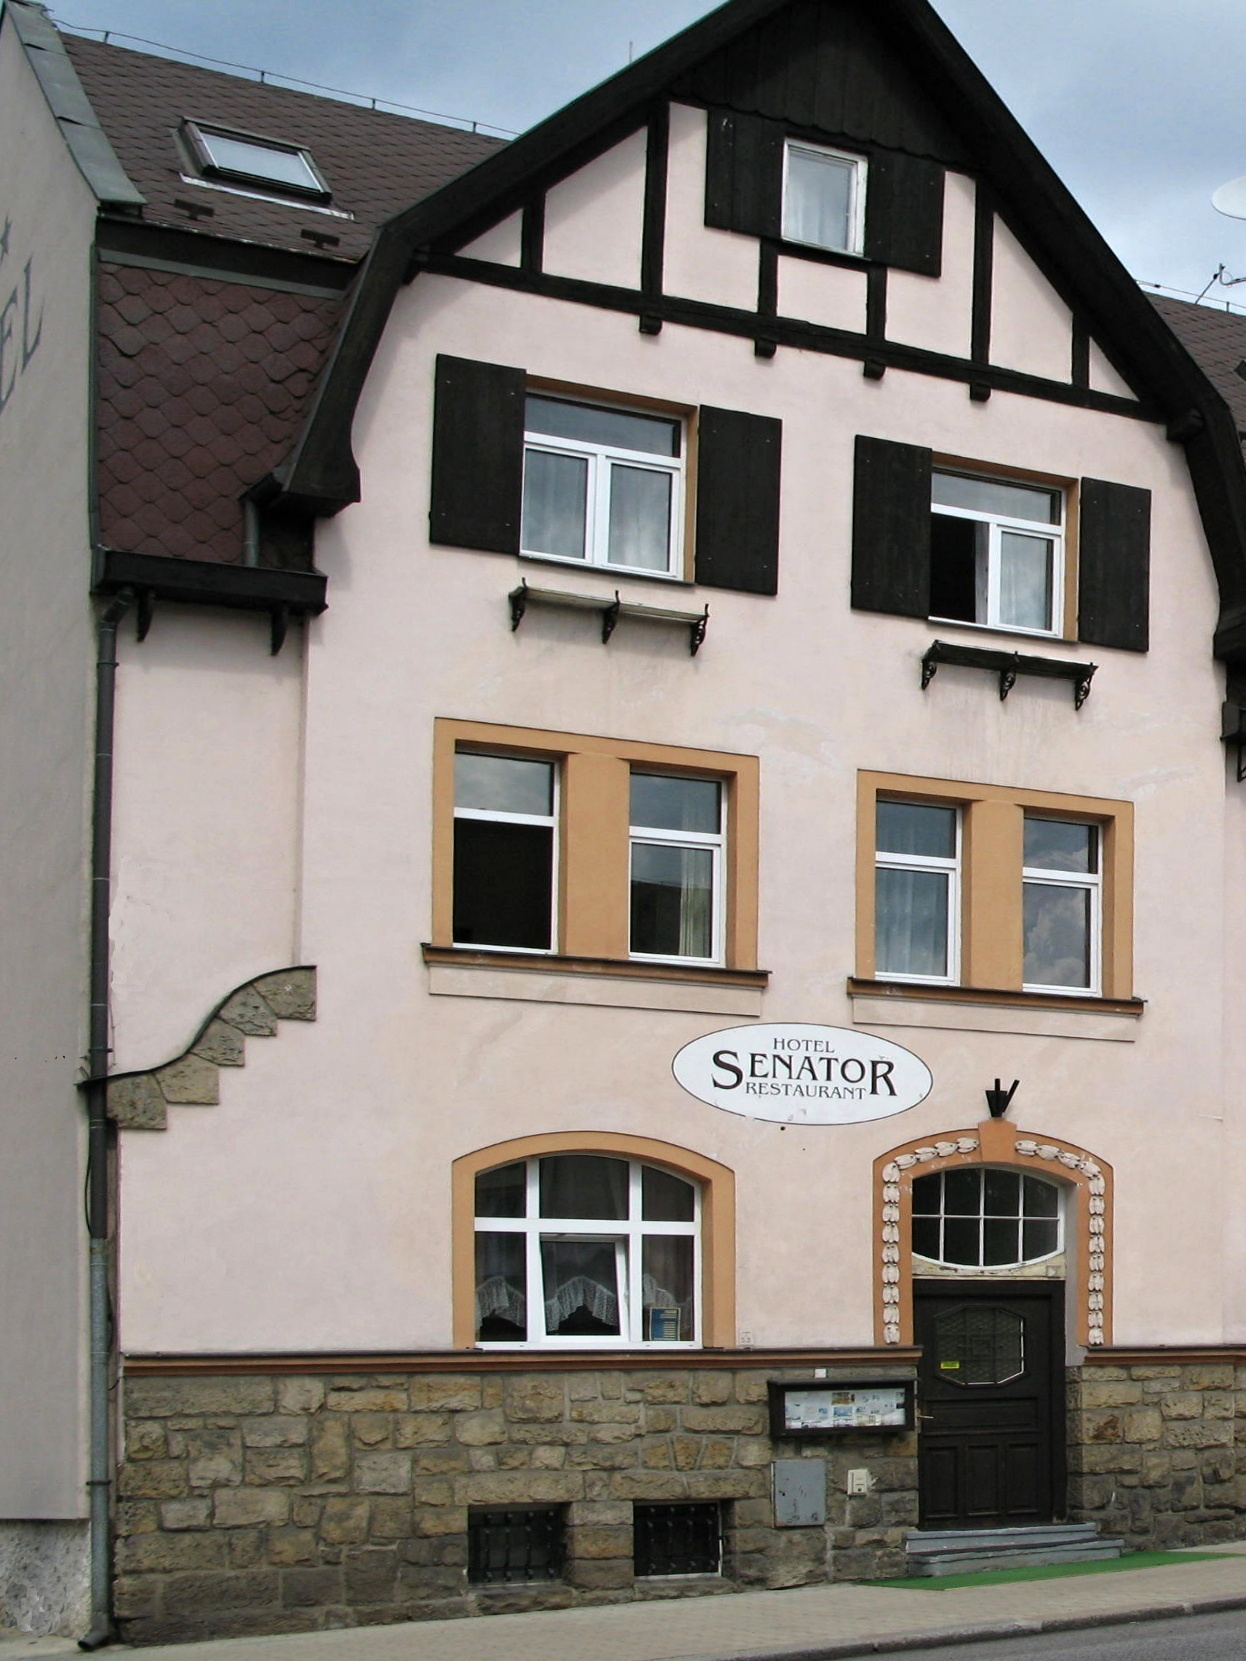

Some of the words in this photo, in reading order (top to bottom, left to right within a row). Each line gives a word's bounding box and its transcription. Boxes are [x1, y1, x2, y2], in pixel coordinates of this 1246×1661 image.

[773, 1037, 835, 1053] HOTEL
[711, 1049, 898, 1097] SENATOR
[745, 1081, 867, 1100] RESTAURANT
